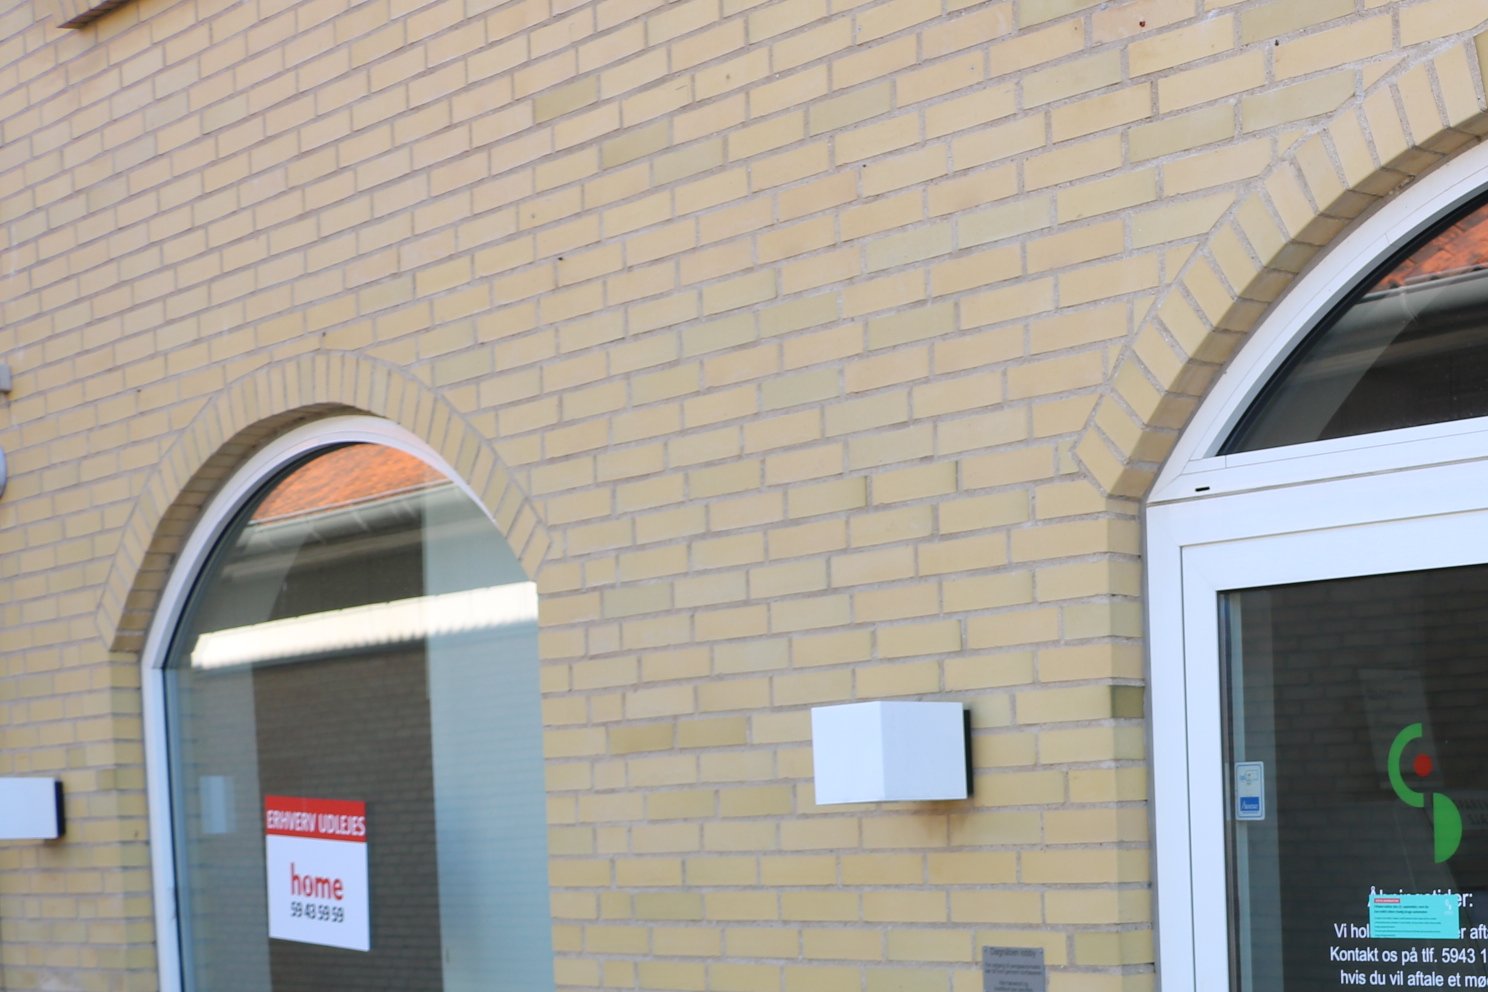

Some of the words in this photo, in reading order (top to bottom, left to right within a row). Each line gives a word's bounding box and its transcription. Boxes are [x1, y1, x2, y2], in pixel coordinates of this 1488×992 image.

[266, 809, 316, 833] ERHVERV
[318, 814, 366, 836] UDLEJES
[290, 862, 344, 900] home
[1334, 923, 1348, 938] Vi
[1330, 946, 1378, 962] Kontakt
[1382, 951, 1398, 963] os
[1401, 947, 1418, 966] på
[1422, 948, 1438, 964] tlf.
[1442, 948, 1475, 964] 5943
[1340, 970, 1366, 985] hvis
[1370, 970, 1386, 986] du
[1390, 970, 1404, 986] vil
[1407, 971, 1444, 987] aftale
[1448, 974, 1461, 987] et
